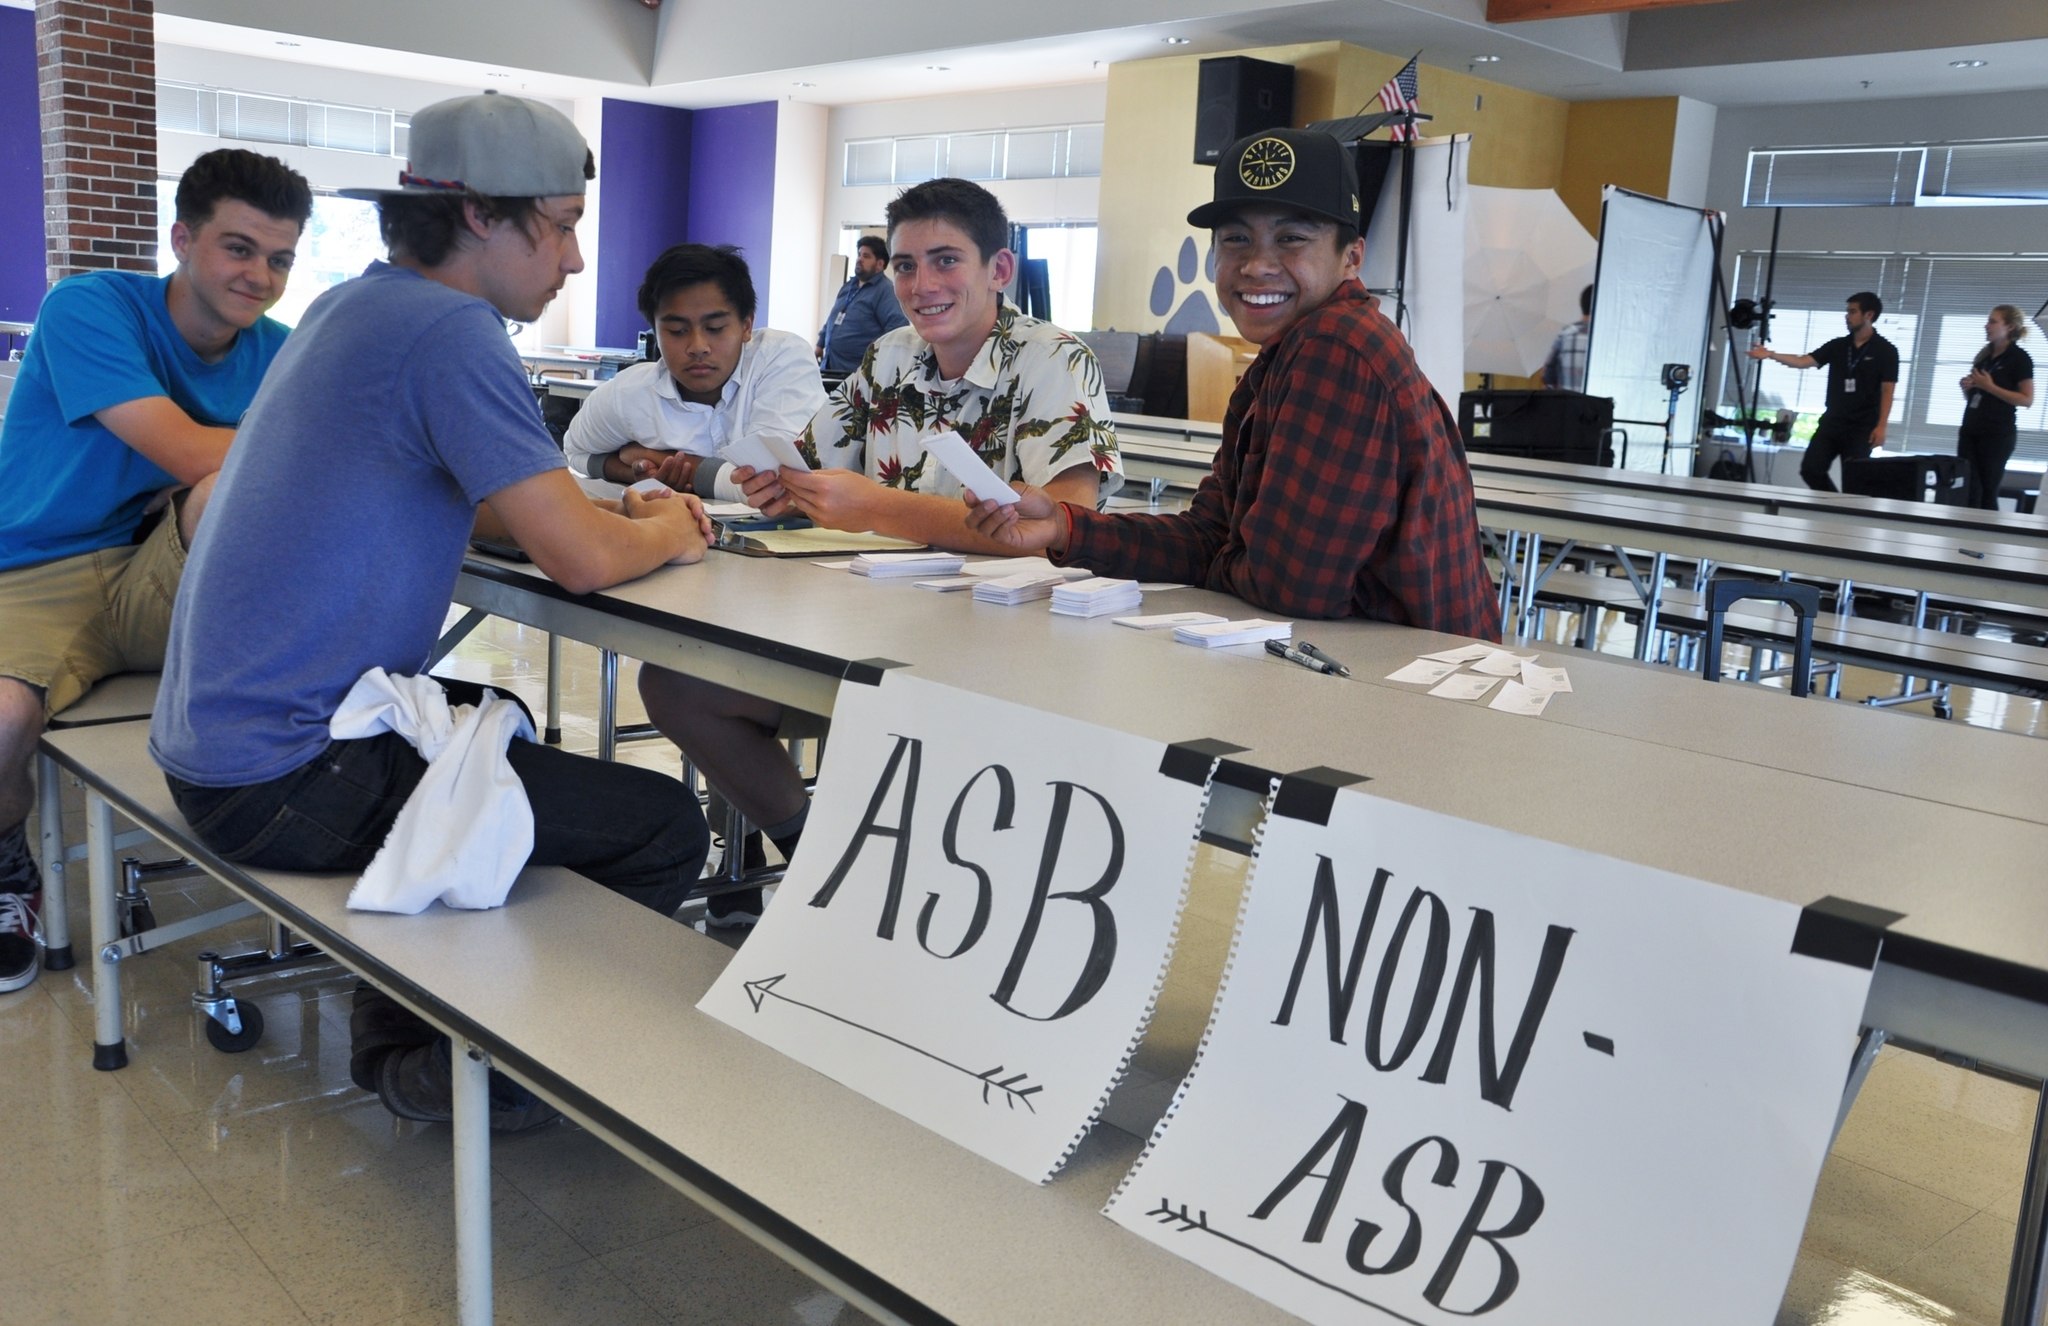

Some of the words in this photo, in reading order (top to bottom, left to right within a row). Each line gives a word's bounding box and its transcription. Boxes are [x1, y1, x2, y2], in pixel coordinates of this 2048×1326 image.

[1243, 167, 1289, 186] MARINERS
[1245, 141, 1289, 160] SEATTLE
[808, 733, 1125, 1021] ASB
[1247, 1093, 1545, 1317] ASB
